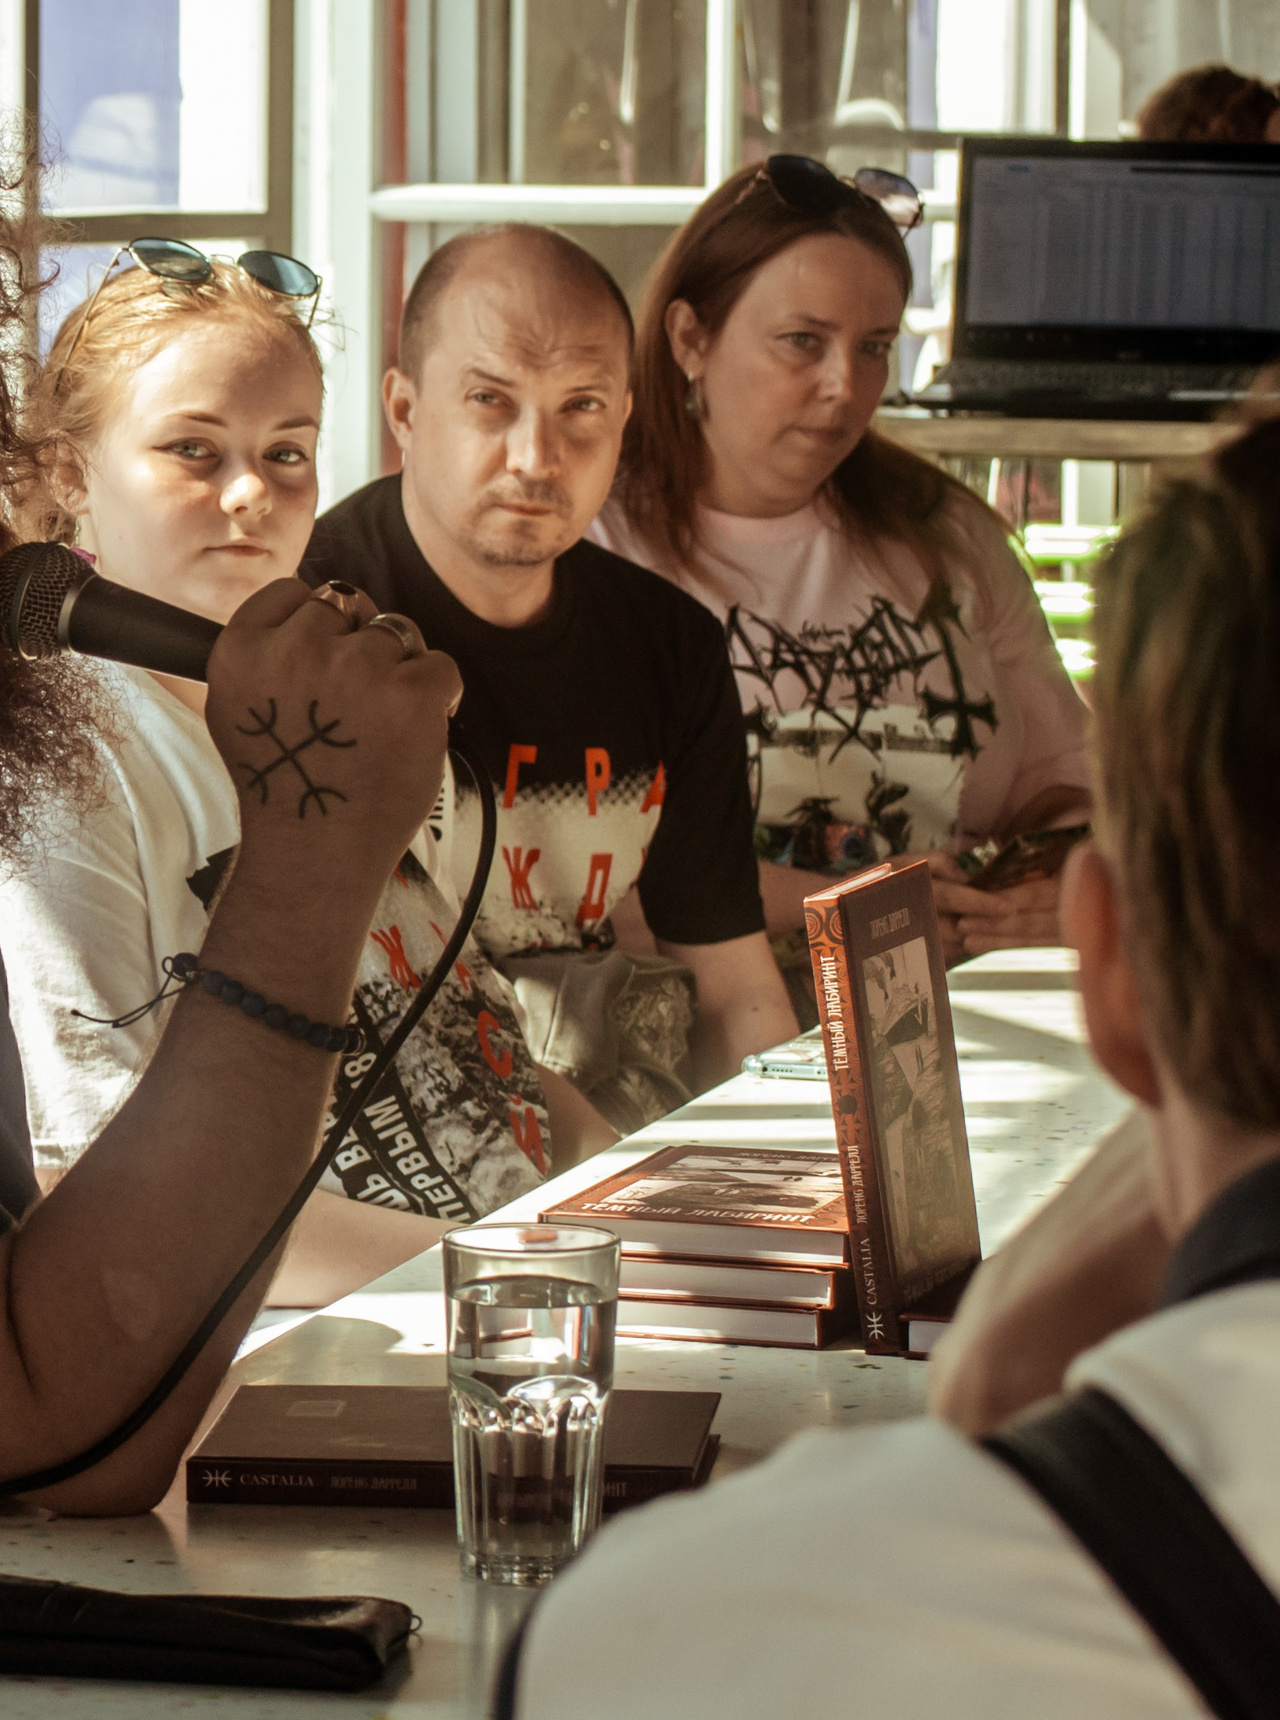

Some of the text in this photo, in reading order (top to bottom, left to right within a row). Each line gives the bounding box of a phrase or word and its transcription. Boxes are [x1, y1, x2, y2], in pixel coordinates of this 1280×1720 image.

[820, 956, 842, 1017] ЛАБИРИНТ
[847, 1145, 864, 1187] ДАРРЕЛЛ
[683, 1208, 817, 1223] ЛАБИРИНТ
[860, 1238, 877, 1305] CASTALIA
[239, 1473, 315, 1487] CASTALIA
